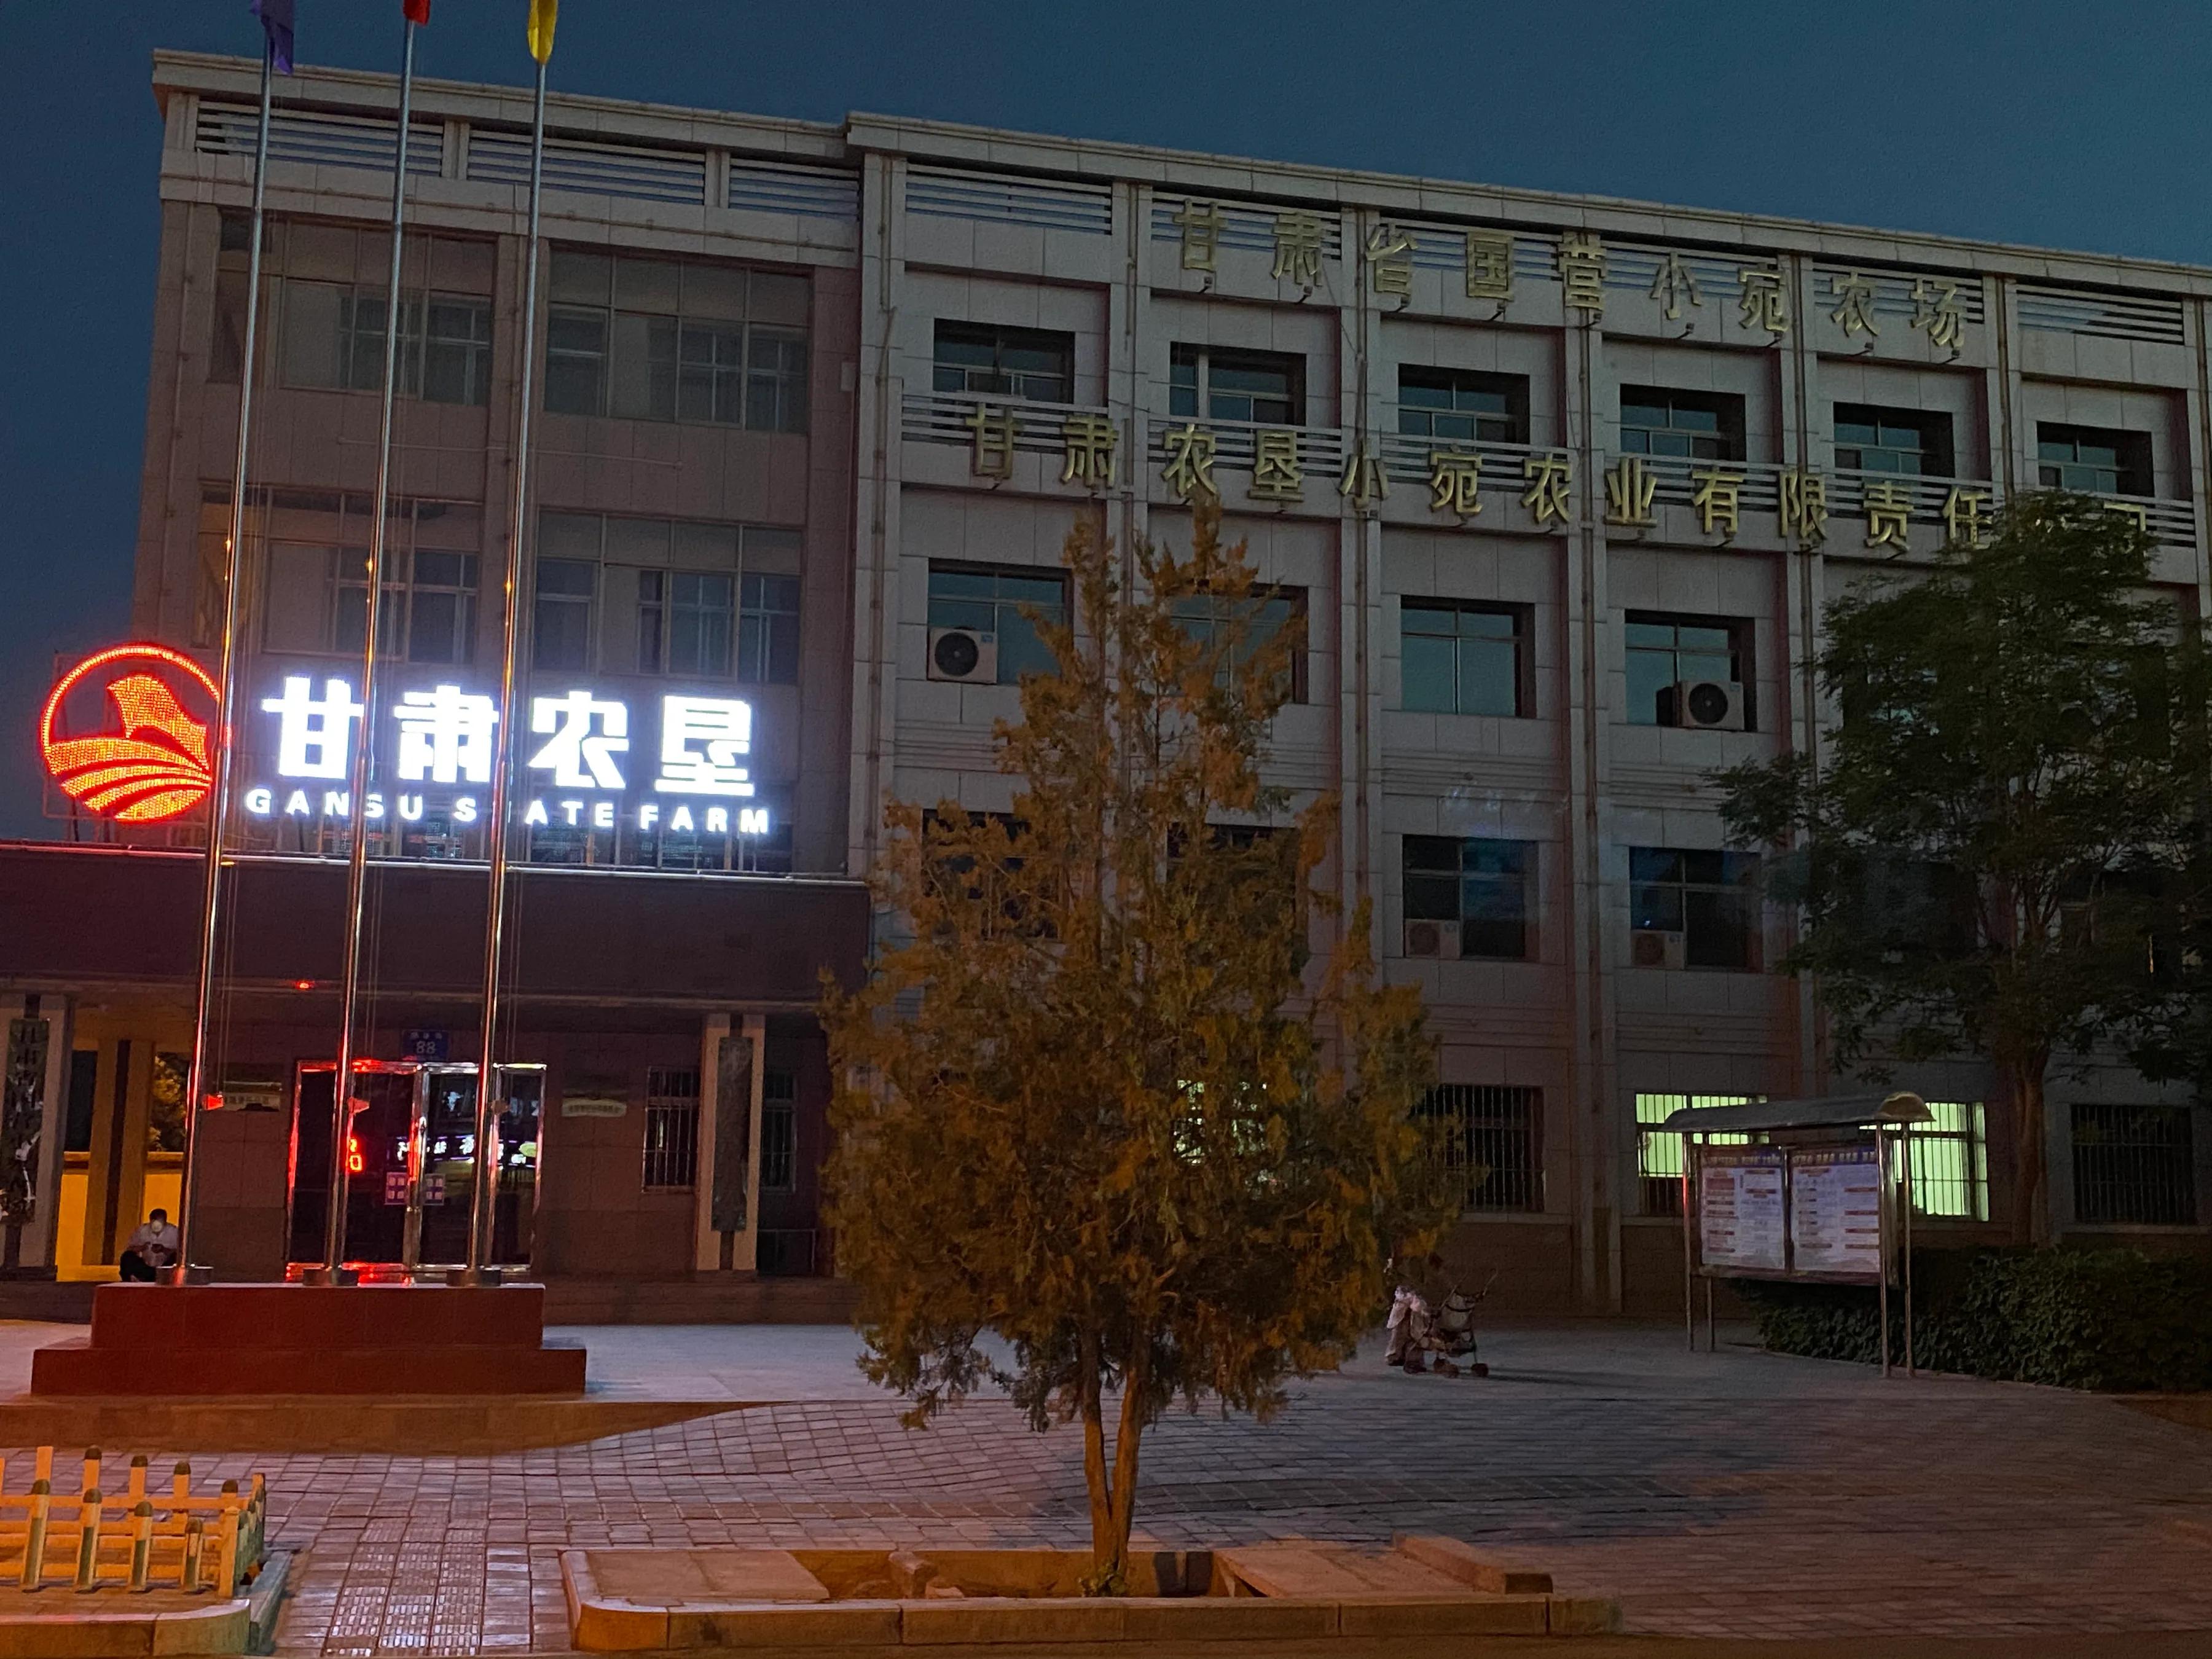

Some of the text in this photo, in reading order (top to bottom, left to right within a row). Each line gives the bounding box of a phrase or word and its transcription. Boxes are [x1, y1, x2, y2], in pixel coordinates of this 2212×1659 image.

[1174, 197, 1966, 348] 甘肃省国营小宛农场
[965, 402, 2147, 556] 甘肃农垦小宛农业有限责任
[262, 676, 755, 797] 甘肃农垦
[245, 788, 769, 834] GANSU SATE FARM
